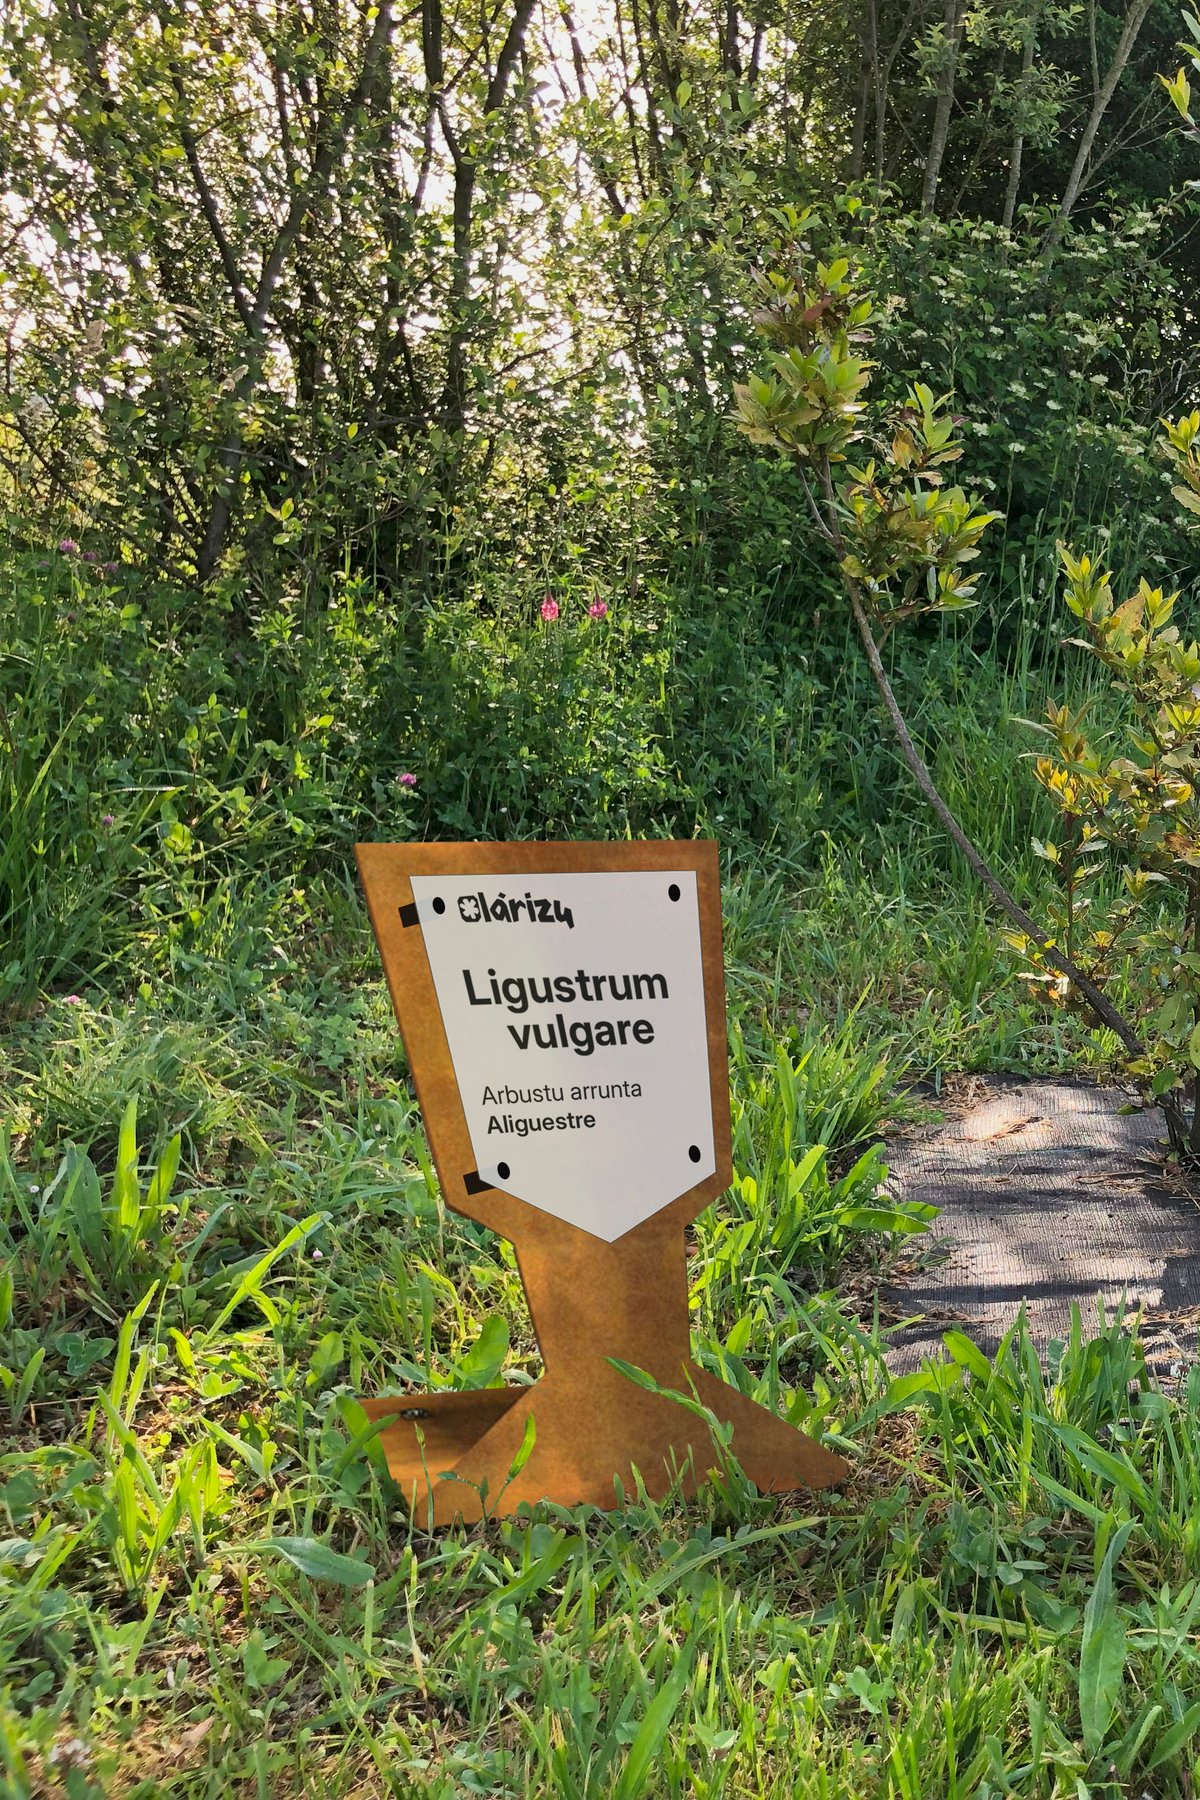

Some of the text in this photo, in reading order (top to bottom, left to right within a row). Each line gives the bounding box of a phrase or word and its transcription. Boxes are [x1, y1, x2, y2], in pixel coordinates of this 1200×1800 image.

[462, 968, 670, 1014] Ligustrum
[507, 1013, 655, 1057] vulgare
[482, 1080, 642, 1106] Arbustu arrunta
[487, 1112, 596, 1138] Aliguestre
